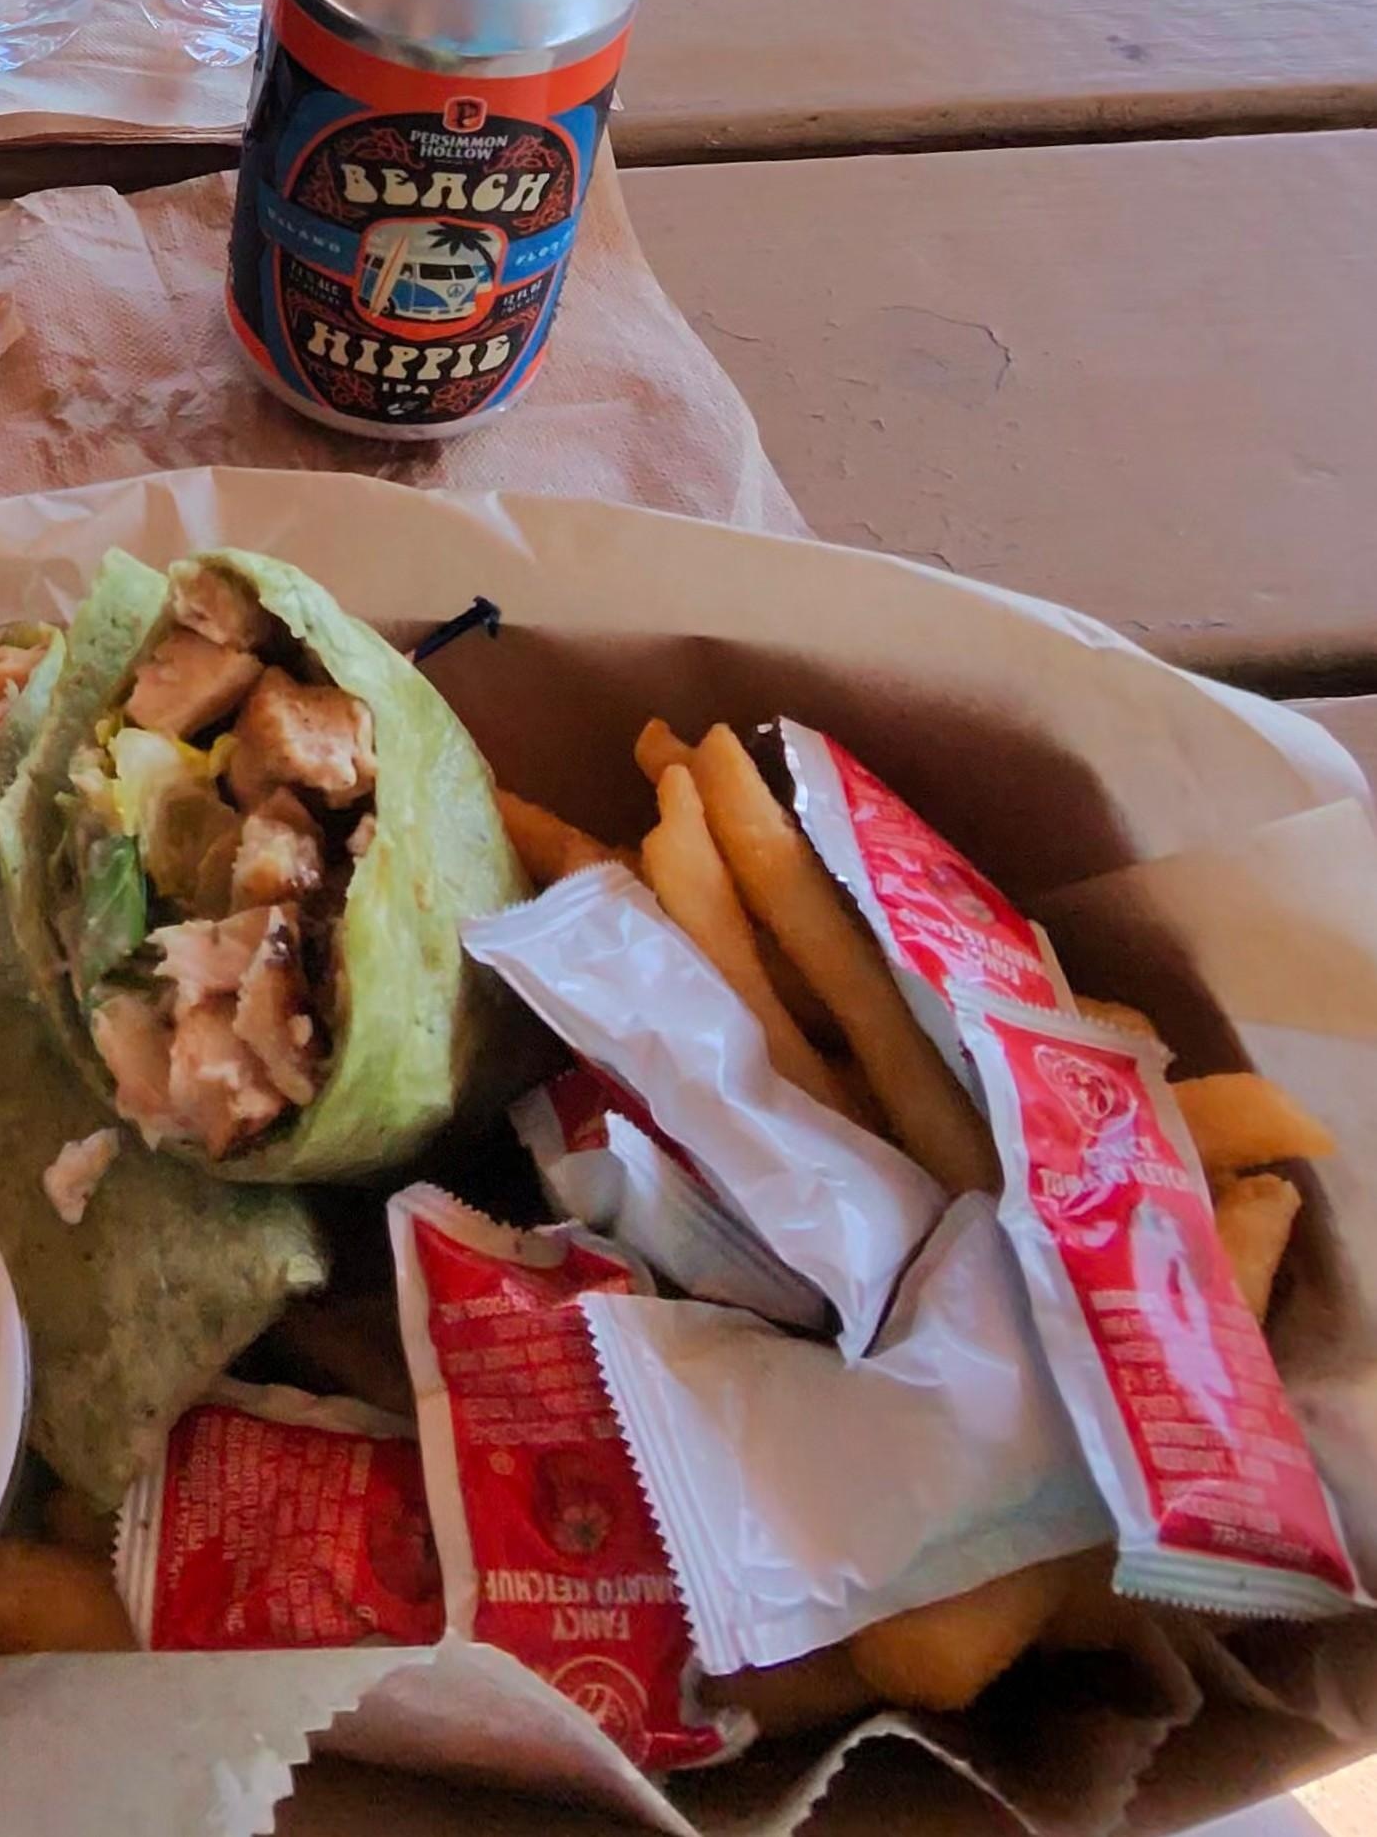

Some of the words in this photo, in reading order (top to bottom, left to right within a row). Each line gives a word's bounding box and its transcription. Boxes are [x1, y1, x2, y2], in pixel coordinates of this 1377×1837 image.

[410, 130, 509, 148] PERSIMMON
[419, 144, 493, 161] HOLLOW
[340, 164, 551, 212] BEACH
[307, 320, 512, 381] HIPPIE
[382, 382, 430, 395] IPA
[552, 1607, 631, 1642] FANCY
